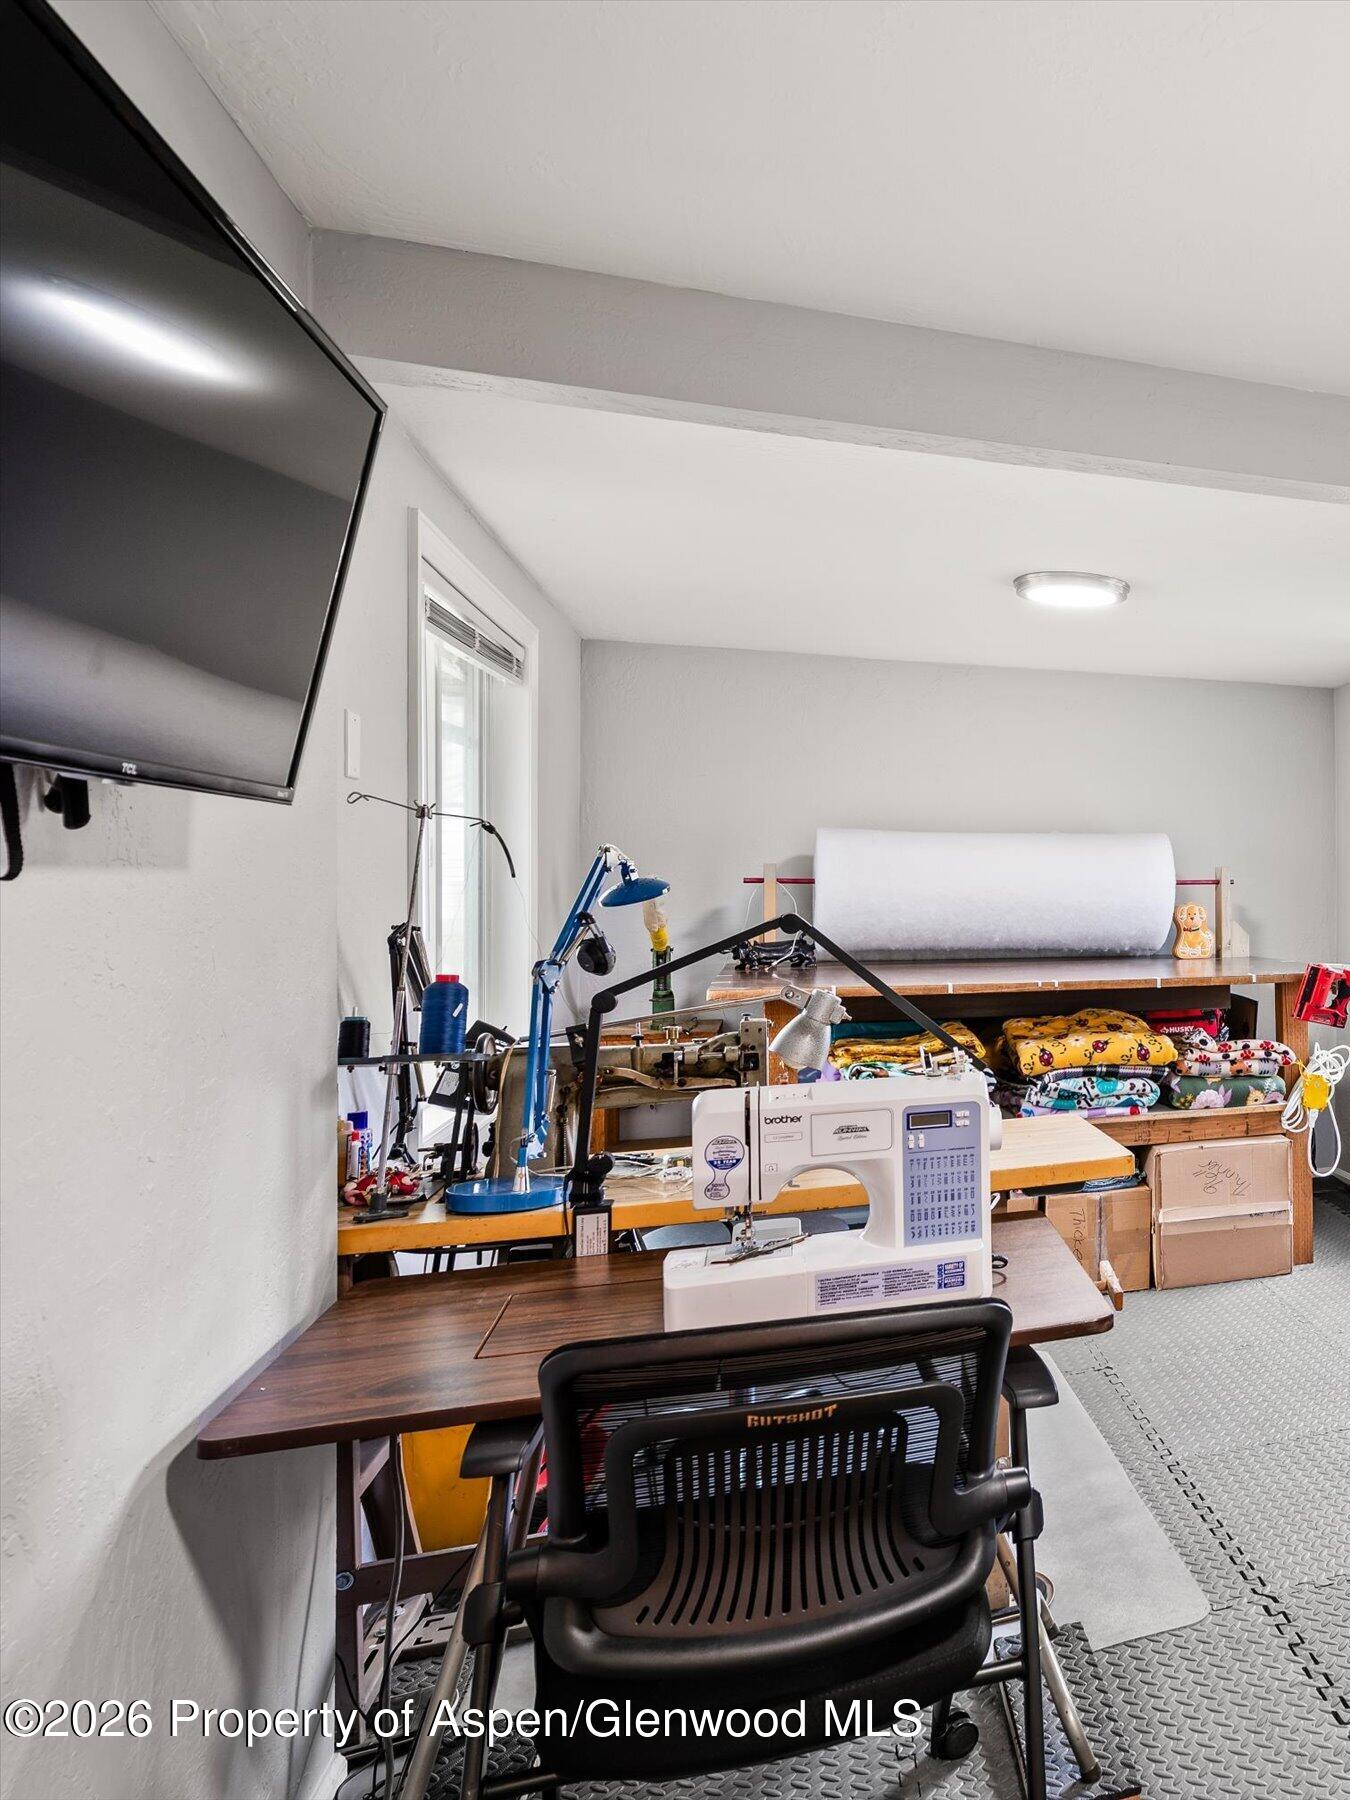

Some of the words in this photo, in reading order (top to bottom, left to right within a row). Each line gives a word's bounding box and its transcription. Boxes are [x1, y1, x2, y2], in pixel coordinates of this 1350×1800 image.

[121, 762, 138, 775] TCL
[1169, 1025, 1194, 1033] HUSKY
[764, 1114, 802, 1124] brother
